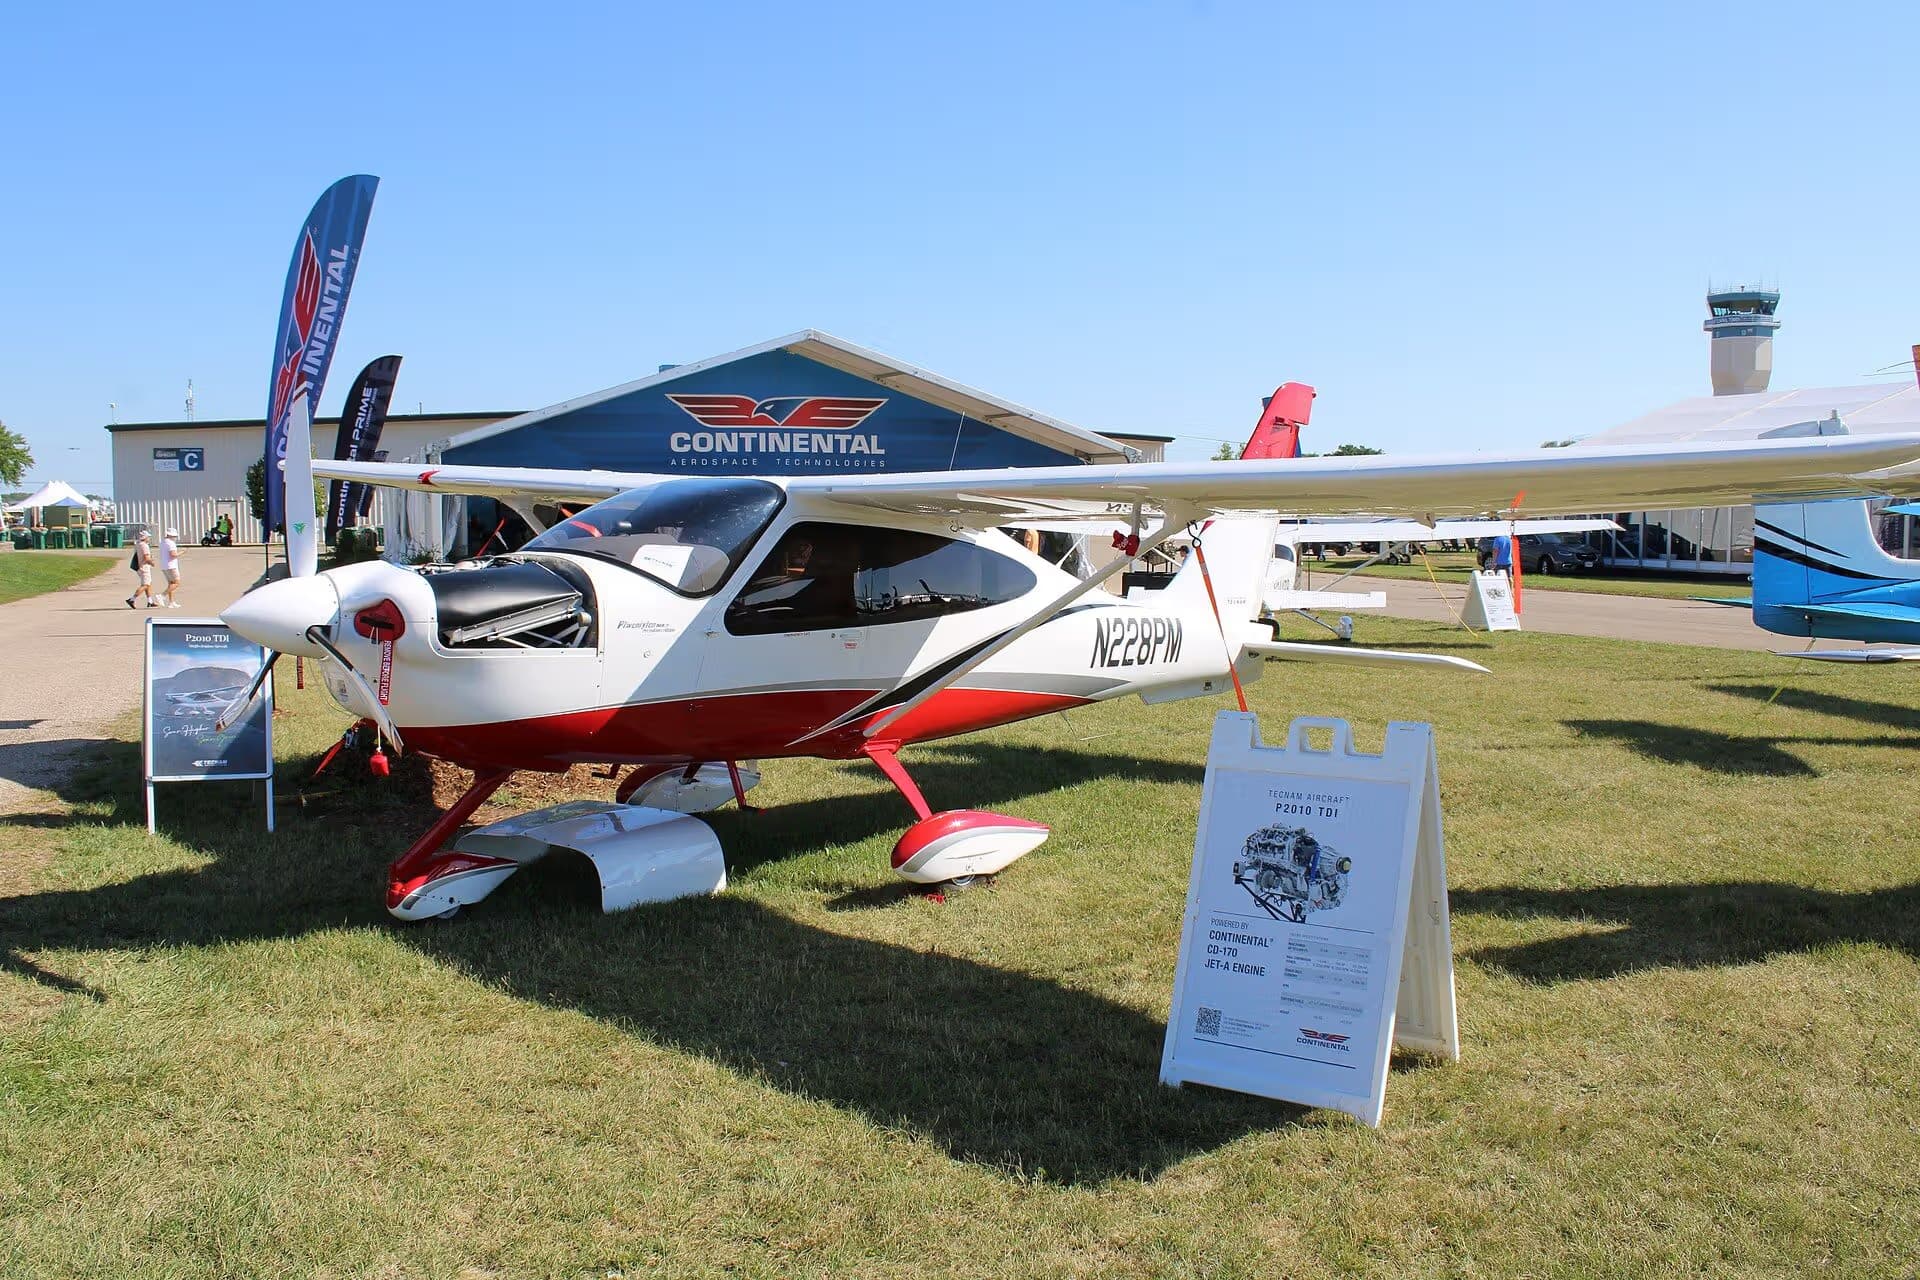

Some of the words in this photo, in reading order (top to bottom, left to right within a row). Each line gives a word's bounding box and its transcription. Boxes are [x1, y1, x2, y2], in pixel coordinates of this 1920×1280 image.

[277, 244, 349, 458] CINENTAL
[670, 432, 885, 455] CONTINENTAL
[184, 452, 199, 469] C
[670, 458, 759, 466] AEROSPACE
[775, 458, 885, 467] TECHNOLOGIES
[337, 444, 359, 527] contintal
[185, 634, 211, 643] P2010
[1090, 617, 1183, 669] N228PM
[1268, 789, 1303, 801] TECNAM
[1275, 802, 1312, 816] P2010
[1318, 806, 1338, 818] TDI
[1210, 918, 1240, 929] POWERED
[1240, 921, 1249, 930] BY
[1207, 943, 1238, 958] CD-170
[1204, 958, 1230, 971] JET-A
[1232, 962, 1266, 977] ENGINE
[1296, 1037, 1350, 1052] CONTINENTAL
